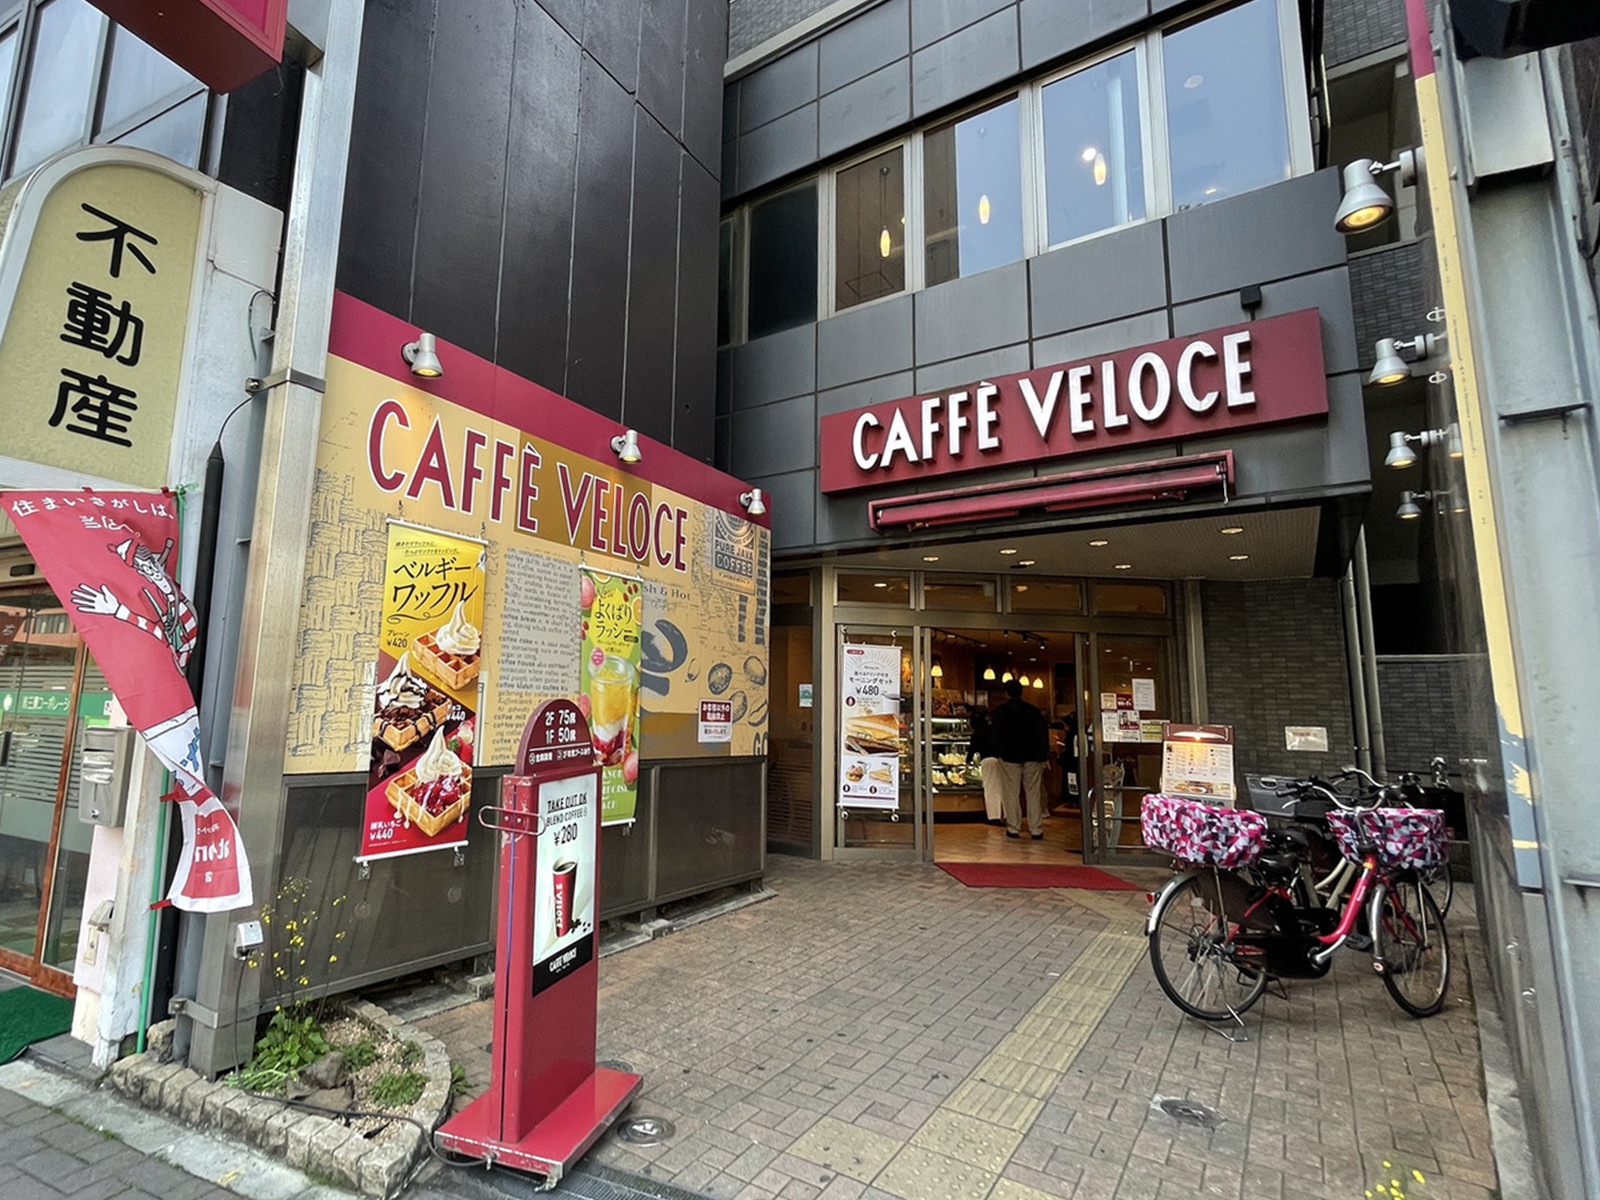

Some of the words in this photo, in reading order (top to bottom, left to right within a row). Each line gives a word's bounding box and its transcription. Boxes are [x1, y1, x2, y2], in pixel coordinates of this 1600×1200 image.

[48, 203, 158, 448] 不動産
[852, 381, 999, 471] CAFFÈ
[1018, 330, 1257, 441] VELOCE
[367, 398, 541, 534] CAFFÈ
[556, 461, 689, 573] VELOCE
[715, 540, 735, 555] PURE
[736, 546, 753, 560] JAVA
[393, 557, 471, 580] ベルギー
[716, 554, 753, 576] COFFEE
[392, 581, 479, 613] ワッフル
[671, 588, 691, 600] Hot
[595, 599, 632, 624] よくばり
[387, 629, 410, 638] プレーン
[596, 620, 632, 639] ラッシー
[386, 638, 408, 648] ¥420
[855, 685, 880, 696] ¥480
[546, 711, 555, 726] 2F
[546, 729, 555, 744] 1F
[548, 797, 564, 811] TAKE
[565, 794, 578, 809] OUT
[579, 792, 587, 805] OK
[546, 813, 563, 827] BLEND
[565, 808, 583, 822] COFFEE
[370, 828, 393, 841] ¥440
[554, 822, 578, 846] ¥280
